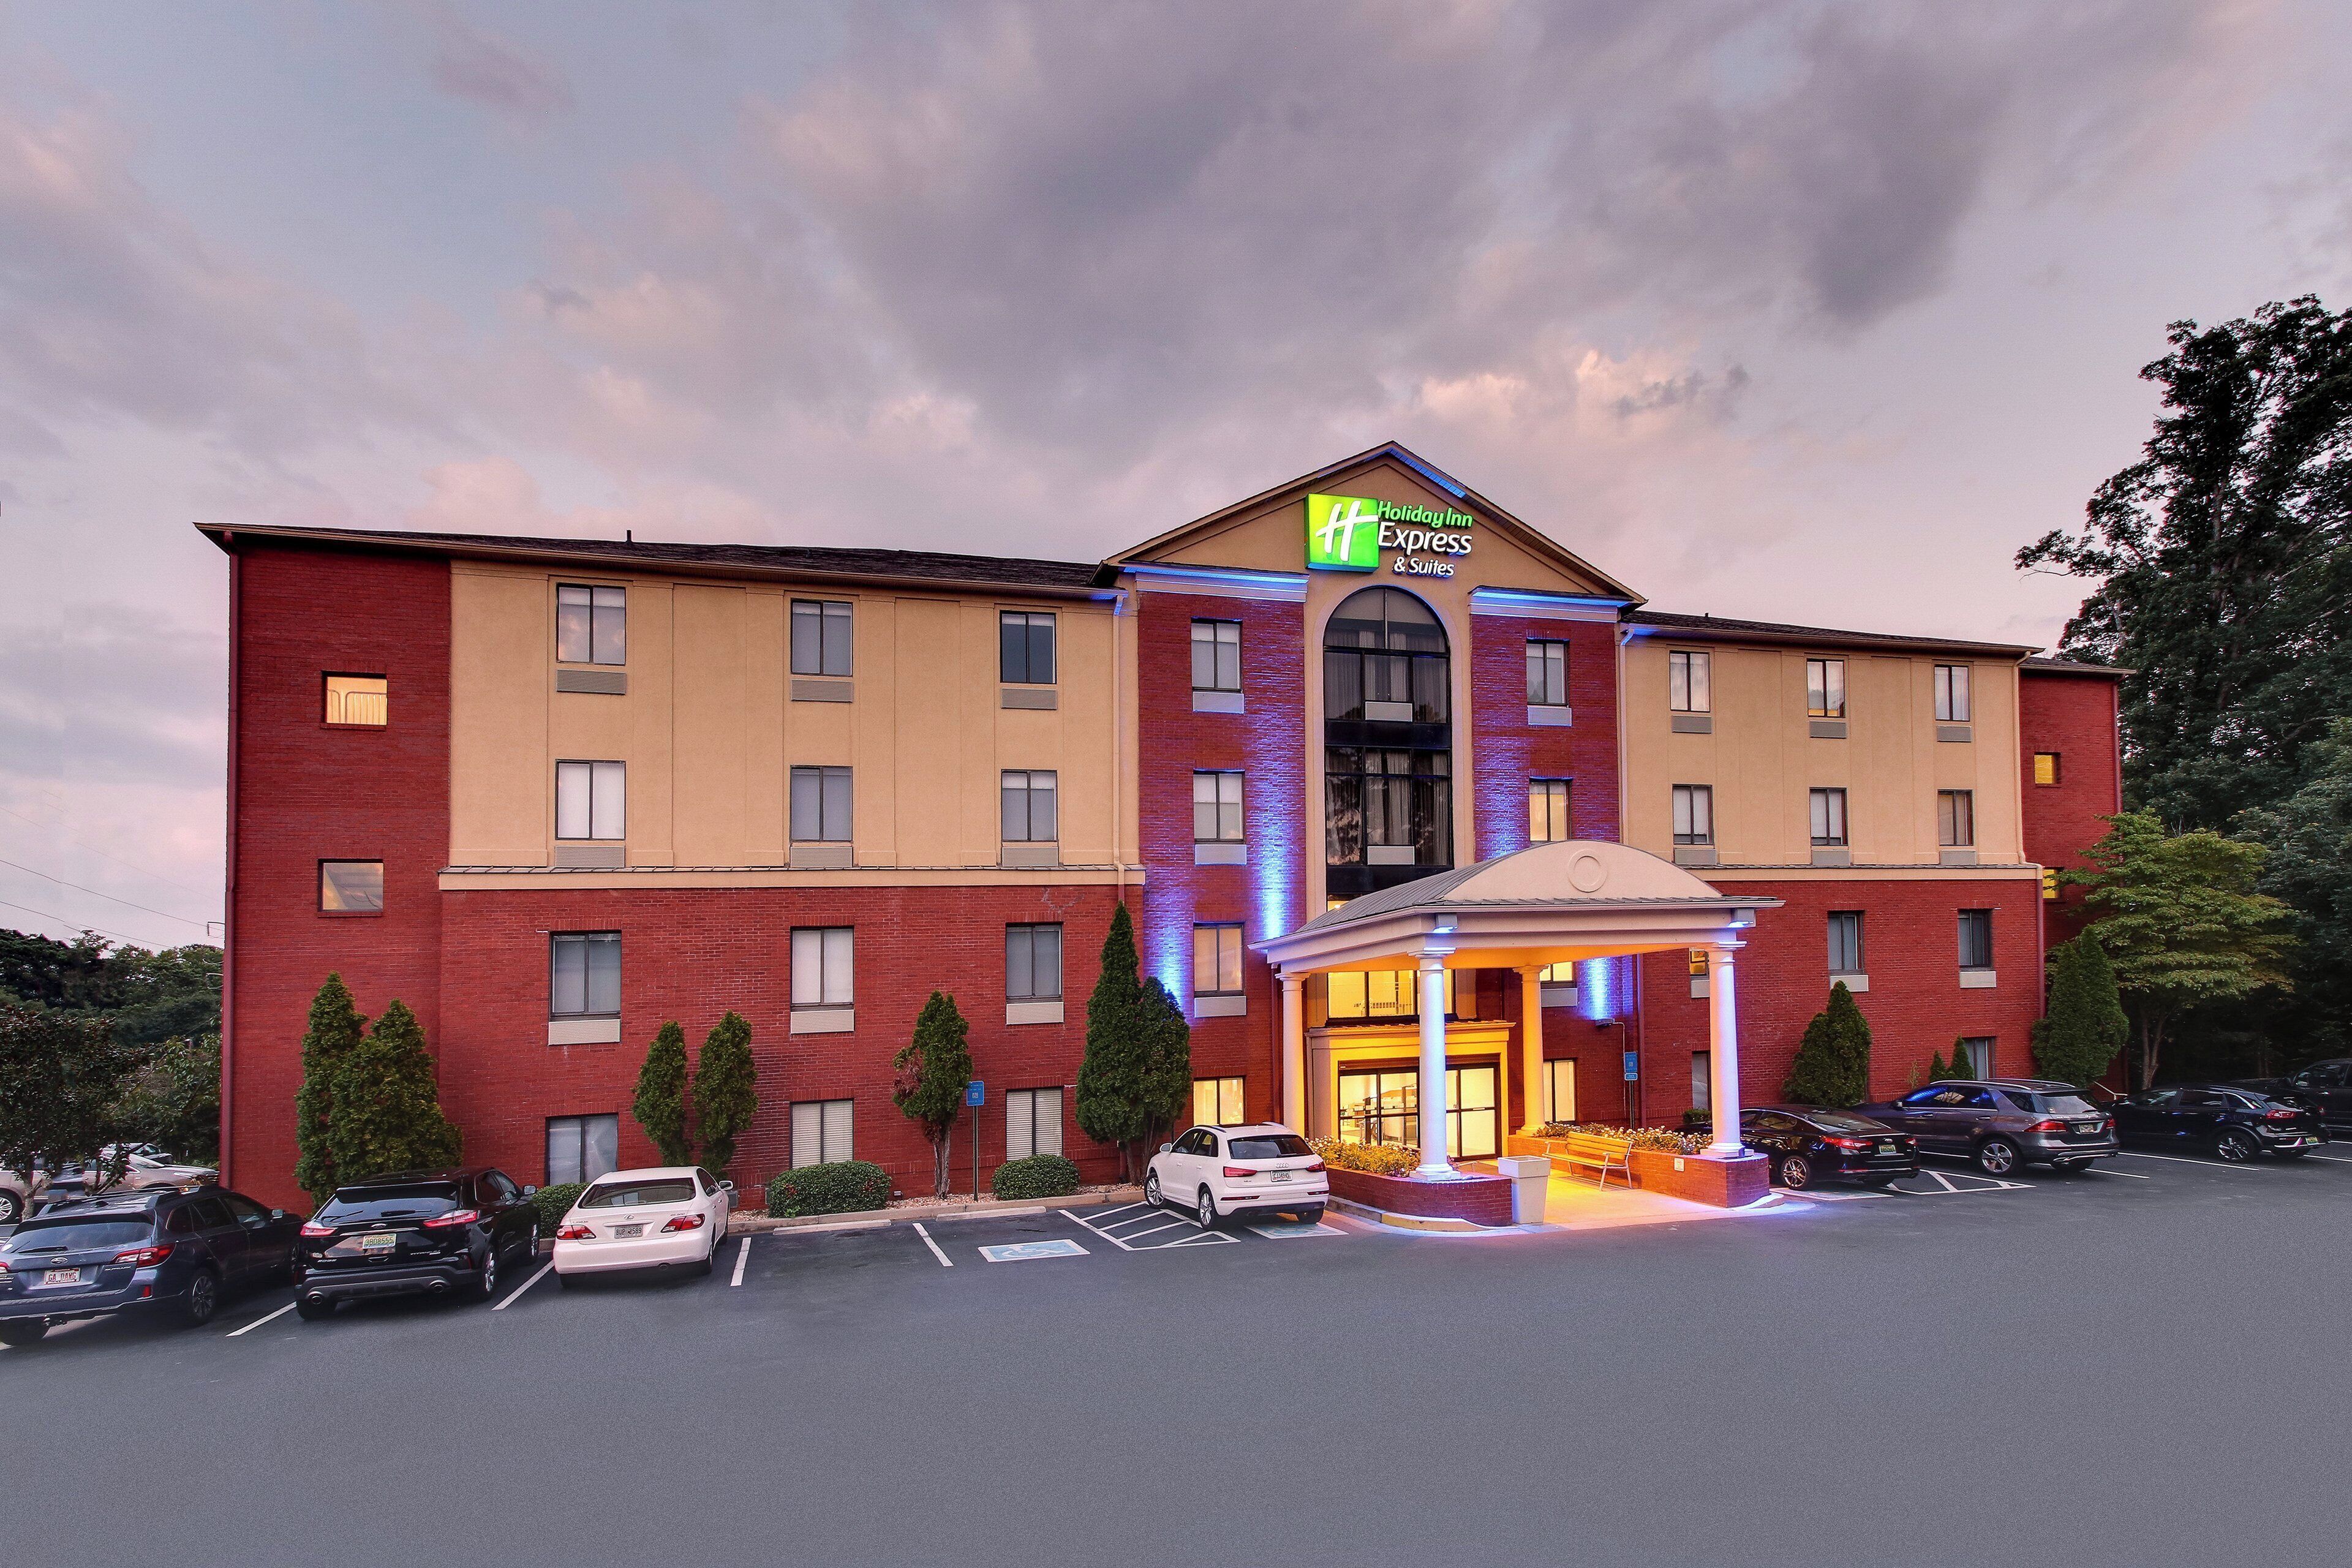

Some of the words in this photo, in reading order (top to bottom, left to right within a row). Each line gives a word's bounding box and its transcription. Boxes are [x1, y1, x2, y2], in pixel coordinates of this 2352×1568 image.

[1378, 500, 1442, 529] Holiday
[1446, 507, 1473, 527] Inn
[1378, 521, 1472, 556] Express
[1393, 556, 1406, 573] &
[1409, 557, 1454, 576] Suites
[61, 1272, 77, 1281] DAWG
